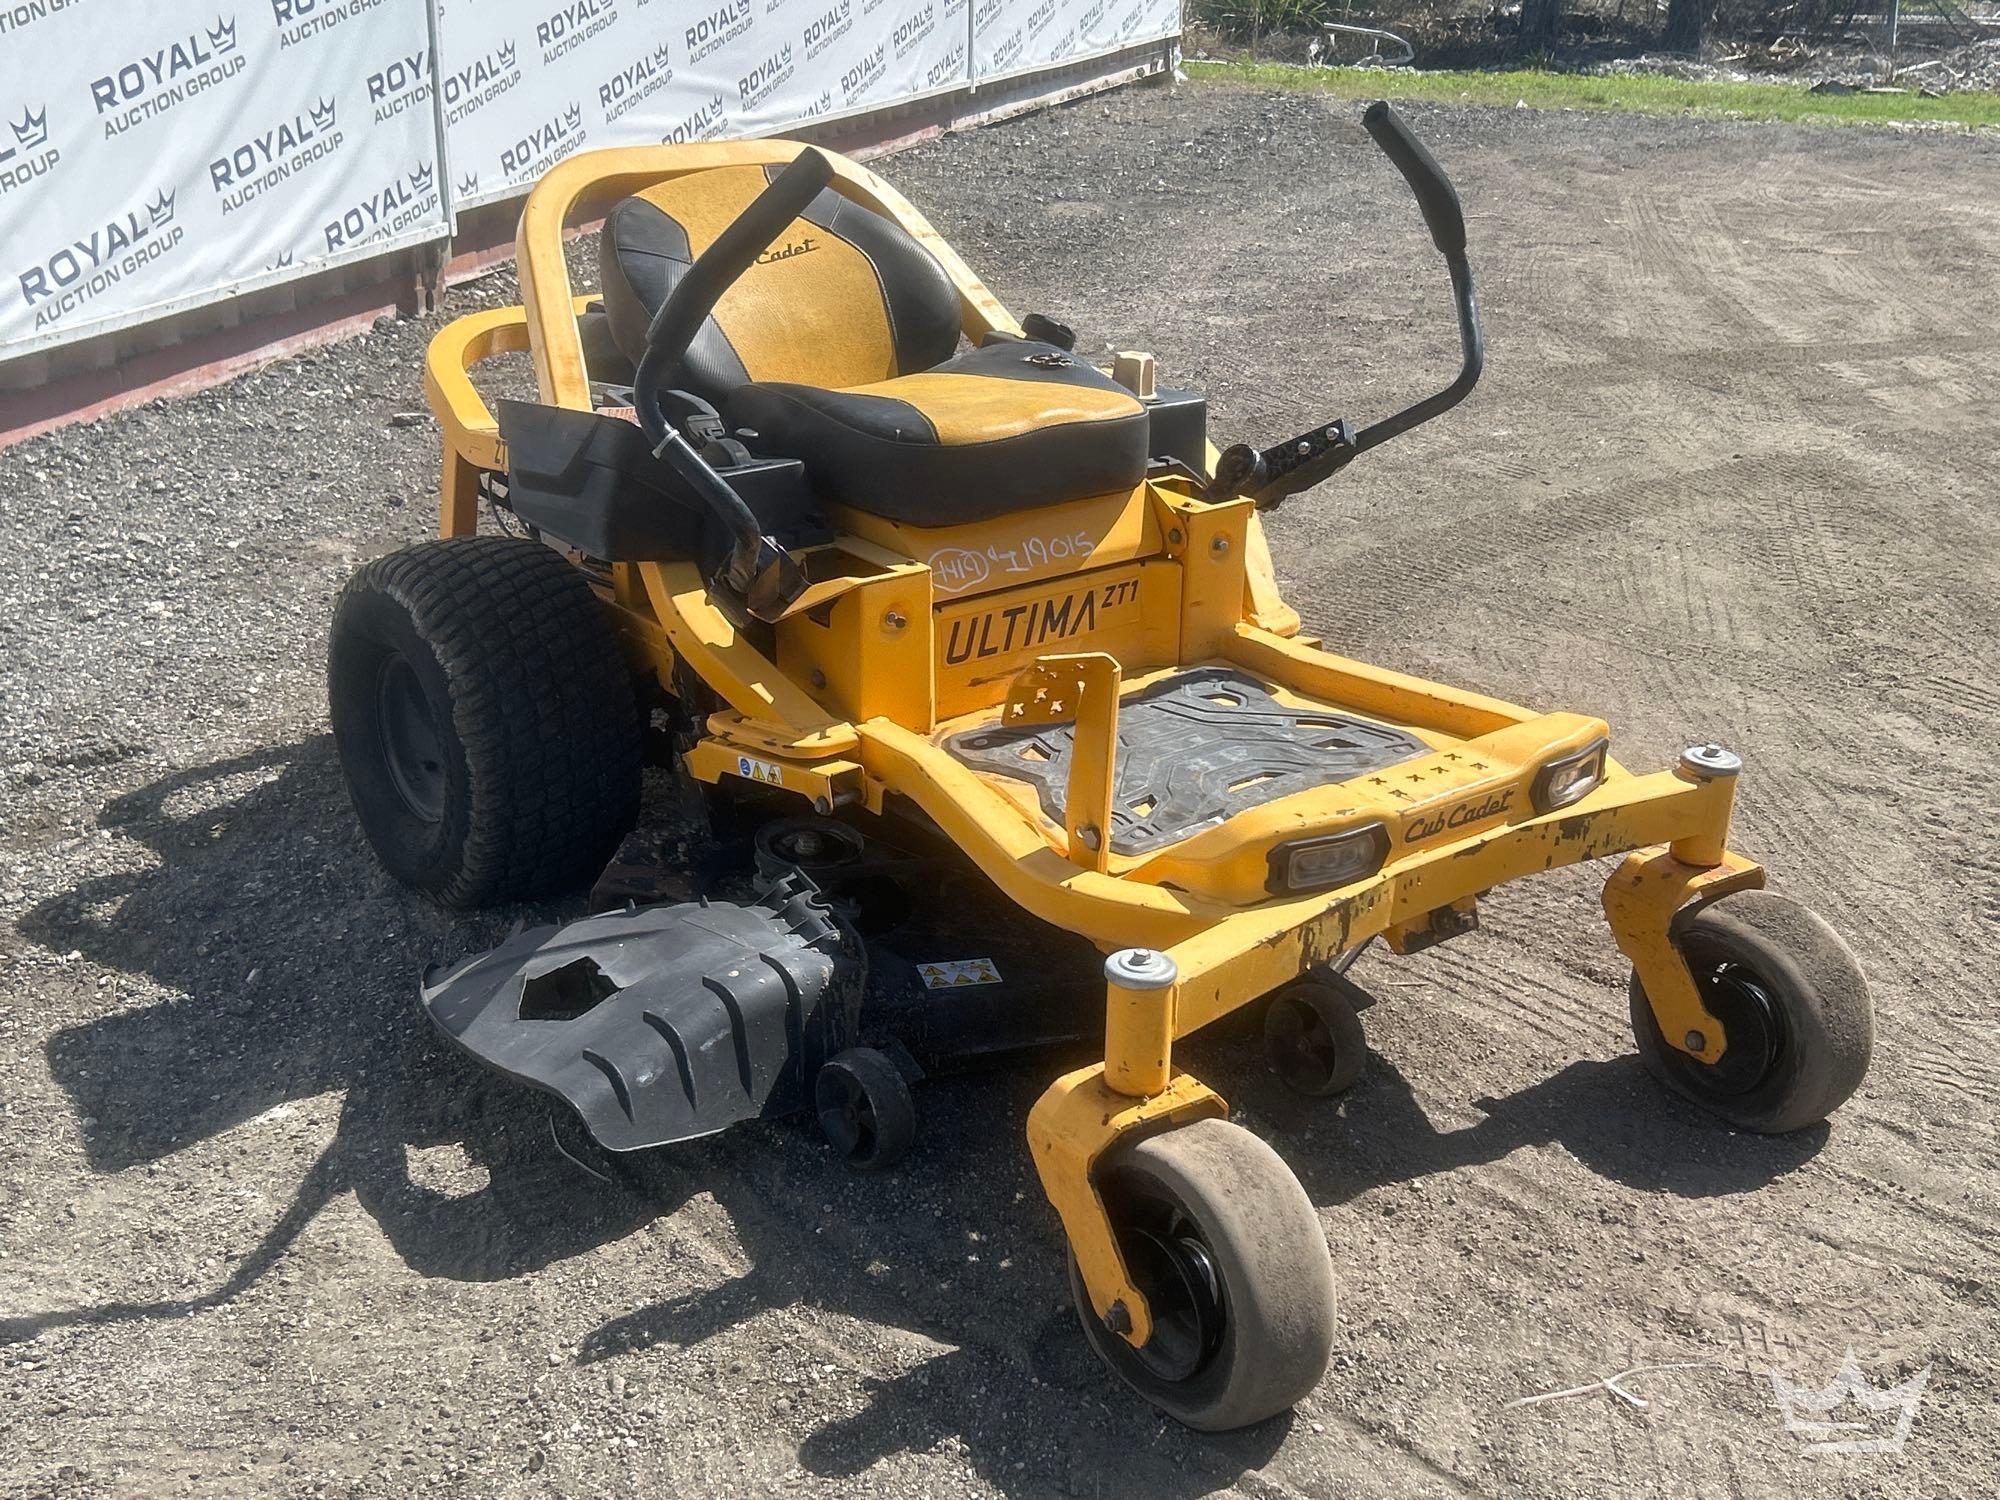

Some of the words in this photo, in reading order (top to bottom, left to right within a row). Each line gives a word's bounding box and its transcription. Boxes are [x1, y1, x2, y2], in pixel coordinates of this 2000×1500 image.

[280, 5, 348, 50] AUCTION
[536, 0, 600, 48] ROYAL
[543, 30, 585, 66] AUCTION
[586, 11, 618, 39] GROUP
[685, 3, 738, 50] ROYAL
[689, 34, 725, 66] AUCTION
[726, 17, 753, 41] GROUP
[803, 6, 841, 48] ROYAL
[806, 34, 832, 62] AUCTION
[833, 18, 853, 41] GROUP
[893, 11, 926, 48] ROYAL
[91, 35, 212, 114] ROYAL
[367, 50, 433, 103] ROY
[444, 54, 501, 104] OYAL
[599, 56, 657, 108] ROYAL
[738, 53, 782, 99] ROYAL
[742, 82, 772, 112] AUCTION
[772, 65, 794, 89] GROUP
[841, 53, 877, 94] ROYAL
[927, 50, 957, 87] ROYAL
[104, 85, 184, 140] AUCTION
[186, 55, 247, 97] GROUP
[446, 94, 484, 128] CTION
[484, 70, 522, 102] GROUP
[605, 90, 643, 125] AUCTION
[643, 69, 673, 97] GROUP
[0, 149, 60, 194] ROUP
[210, 116, 314, 193] ROYAL
[500, 117, 567, 177] ROYAL
[509, 154, 554, 185] UCTION
[554, 130, 587, 163] GROUP
[222, 162, 290, 216] AUCTION
[291, 131, 344, 173] GROUP
[324, 180, 413, 253] ROYAL
[393, 193, 438, 232] GROUP
[18, 212, 149, 306] ROYAL
[756, 239, 820, 264] Cadet
[35, 265, 121, 331] AUCTION
[122, 226, 184, 275] GROUP
[946, 590, 1095, 665] ULTIMA
[1101, 579, 1139, 609] ZT1
[1404, 811, 1446, 843] Cub
[1447, 789, 1514, 828] Cadet
